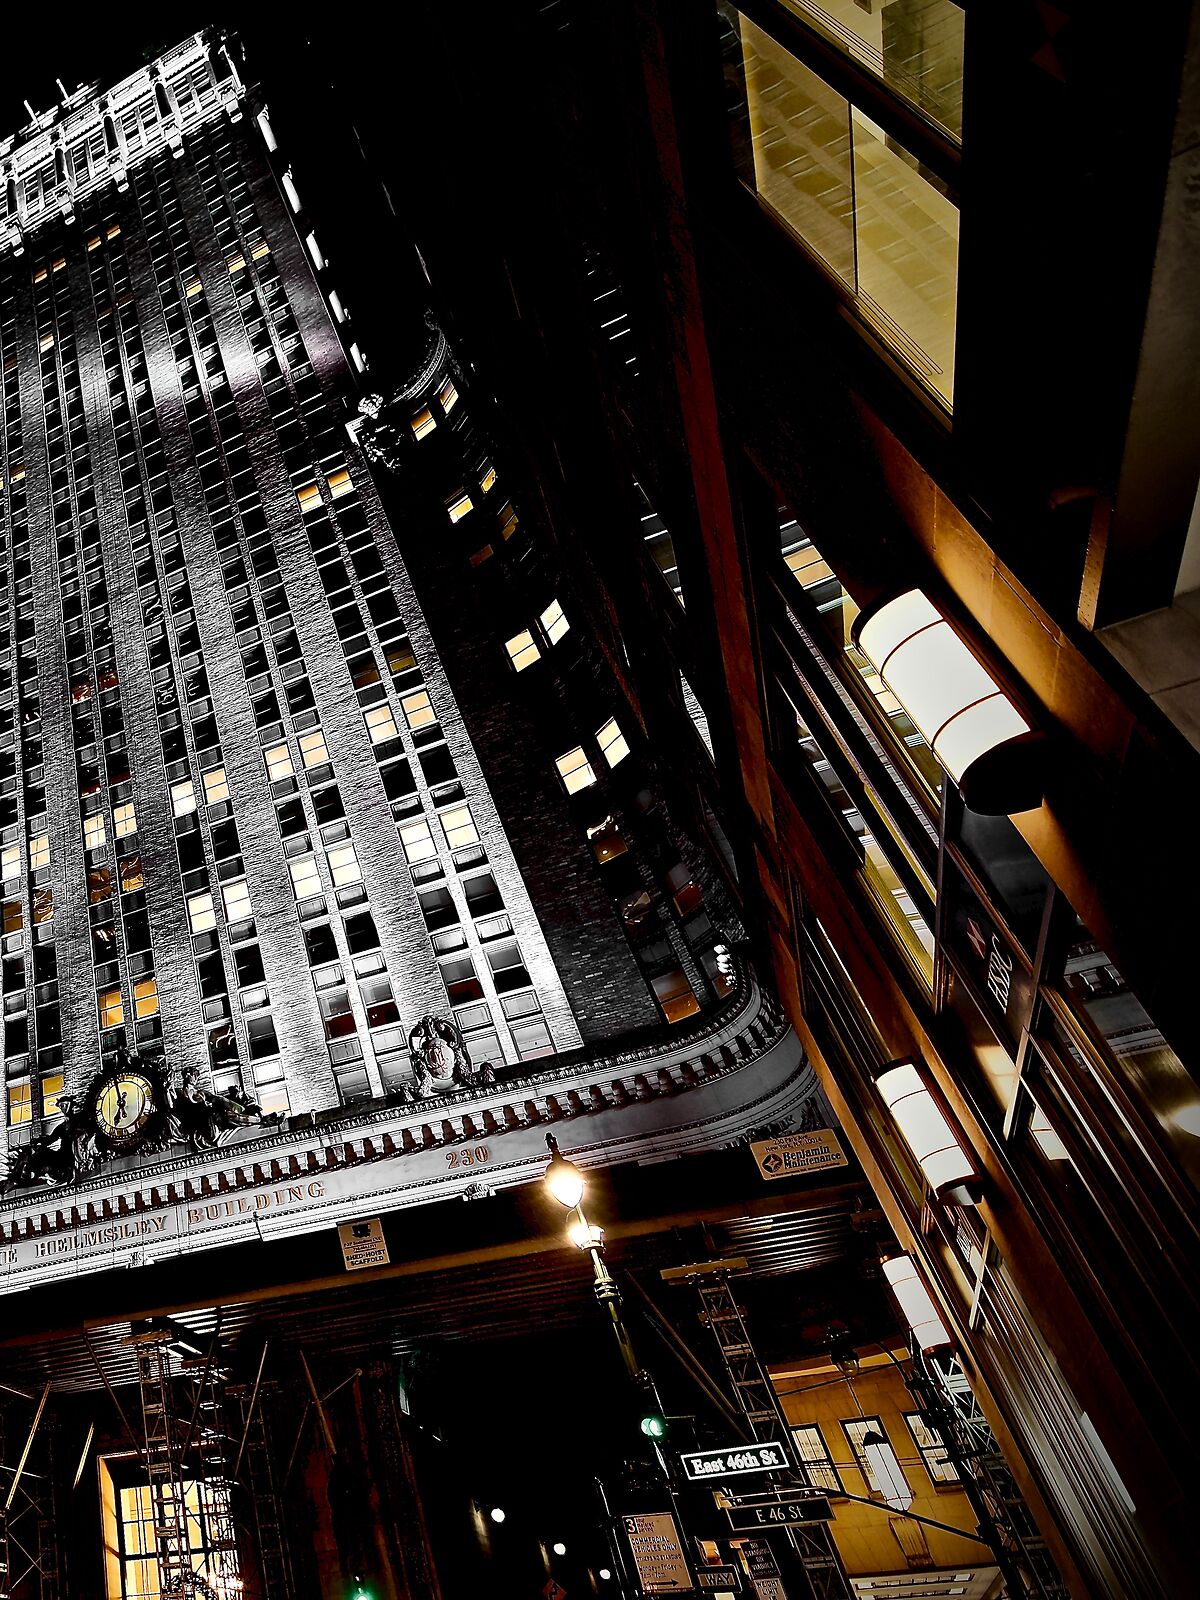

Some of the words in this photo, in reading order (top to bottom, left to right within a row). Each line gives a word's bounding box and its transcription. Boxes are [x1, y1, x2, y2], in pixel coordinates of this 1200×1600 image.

[987, 932, 1013, 1015] HSBC
[446, 1145, 490, 1170] 230
[782, 1145, 830, 1161] Benjamin
[784, 1152, 841, 1170] Maintenance
[34, 1215, 169, 1258] HELMSLEY
[187, 1180, 326, 1226] BUILDING
[351, 1256, 384, 1266] SCAFFOLD
[691, 1456, 726, 1475] East
[727, 1452, 760, 1470] 46th
[759, 1449, 779, 1467] St
[755, 1509, 766, 1523] E
[769, 1507, 786, 1521] 46
[789, 1505, 804, 1519] St
[625, 1518, 636, 1533] 3
[632, 1536, 669, 1545] COMMERCIAL
[633, 1545, 661, 1554] VEHICLES
[662, 1543, 678, 1552] ONLY
[706, 1573, 730, 1585] WAY
[757, 1580, 779, 1588] WEIGHT
